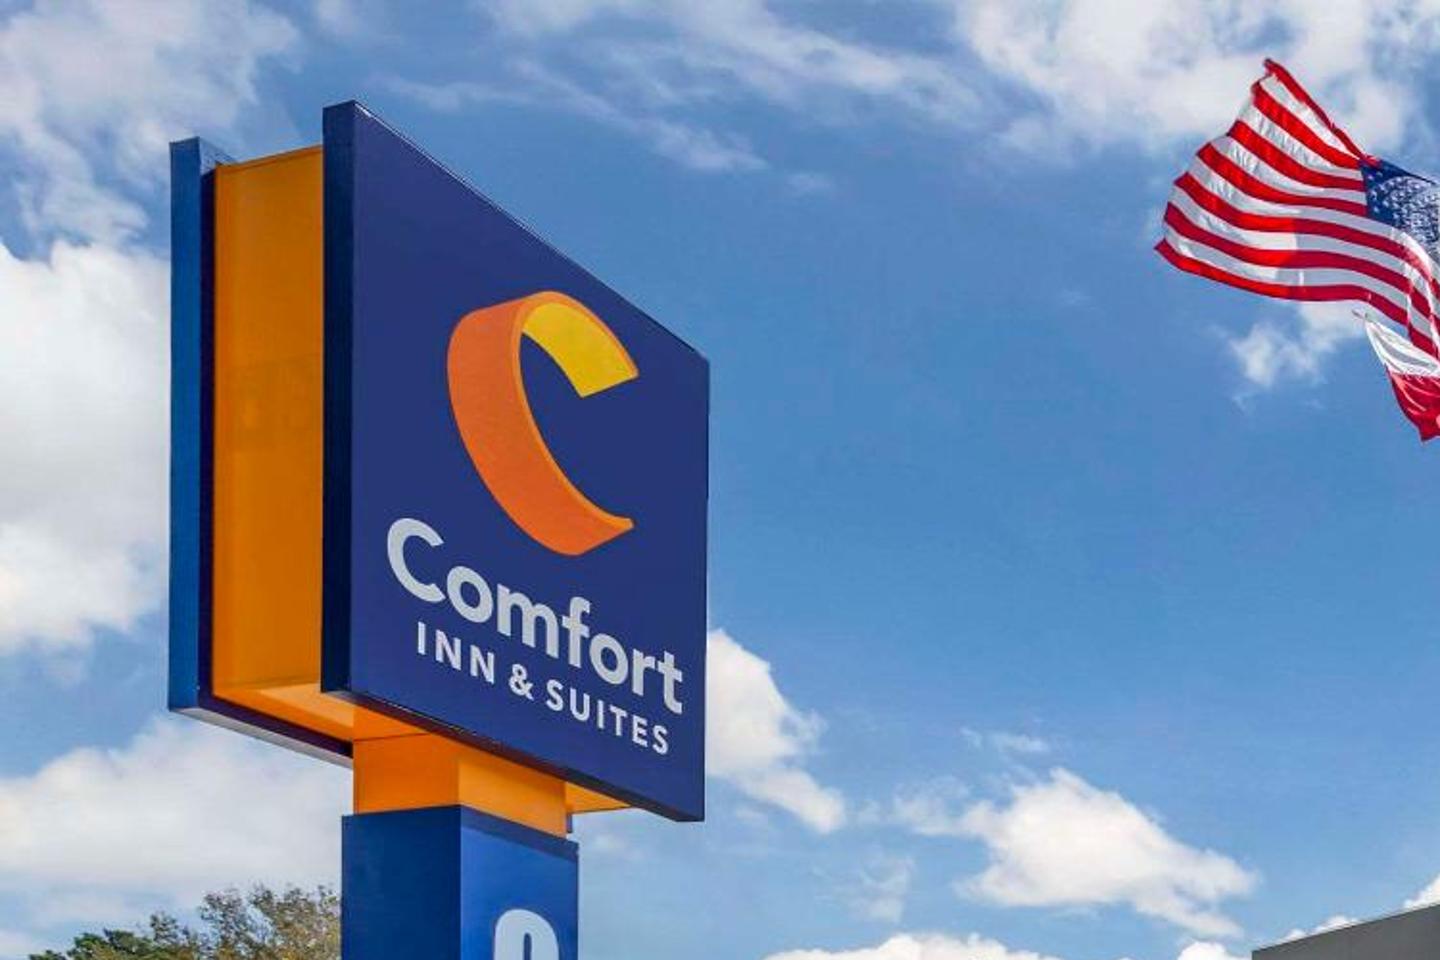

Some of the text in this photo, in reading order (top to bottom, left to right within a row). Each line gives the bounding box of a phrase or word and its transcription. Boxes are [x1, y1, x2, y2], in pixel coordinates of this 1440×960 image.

[386, 517, 684, 715] Comfort
[416, 621, 670, 756] INN & SUITES
